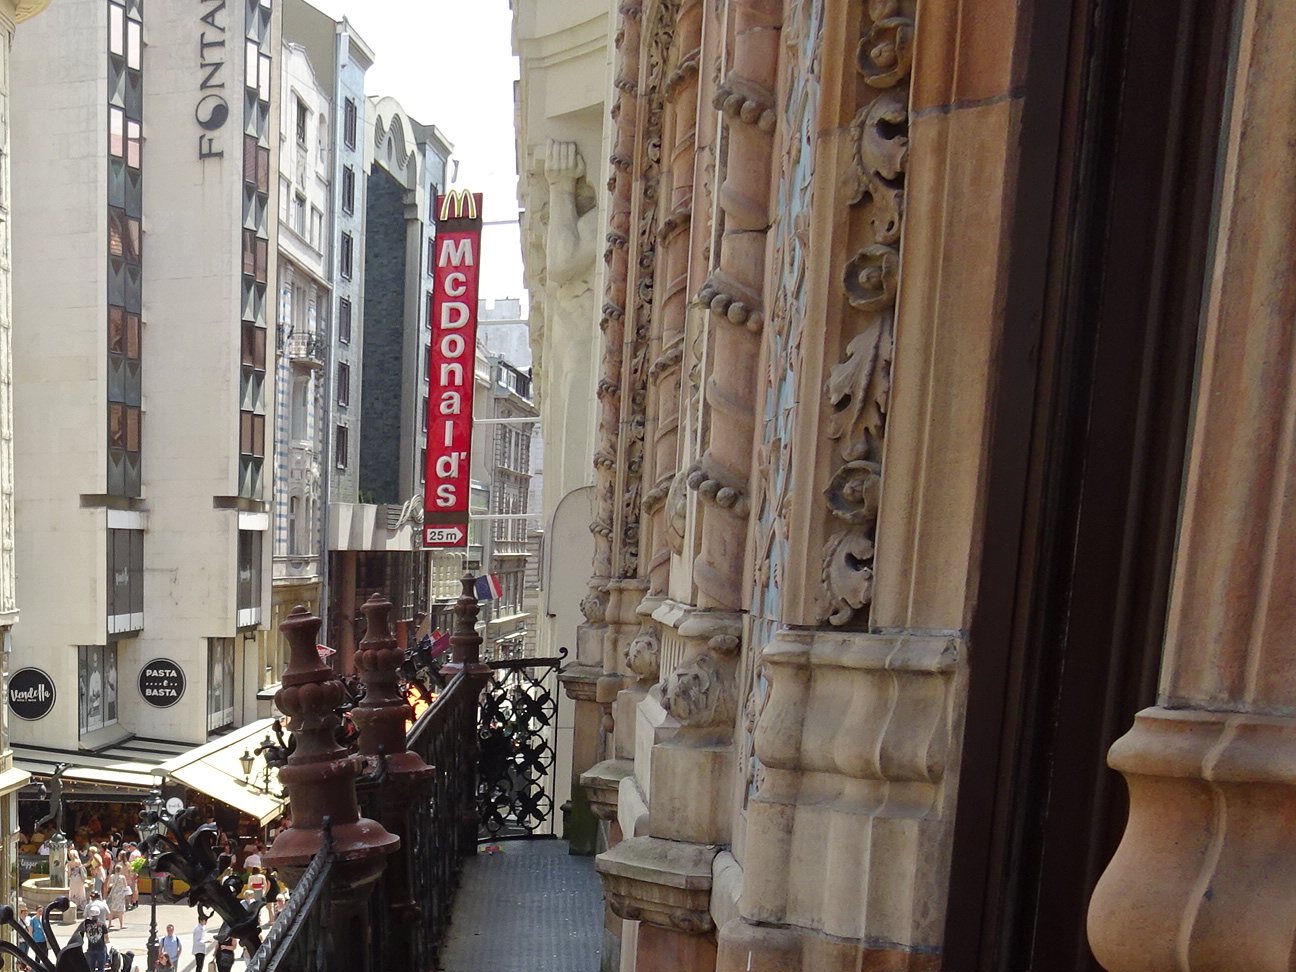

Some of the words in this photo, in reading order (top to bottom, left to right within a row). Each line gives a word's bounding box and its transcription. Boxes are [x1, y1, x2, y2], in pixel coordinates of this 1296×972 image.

[195, 0, 229, 160] FONTA
[435, 238, 474, 508] McDonald's
[429, 530, 444, 541] 25
[444, 532, 457, 541] m
[145, 669, 178, 678] PASTA
[10, 683, 51, 702] Vendetta
[145, 688, 178, 697] BASTA
